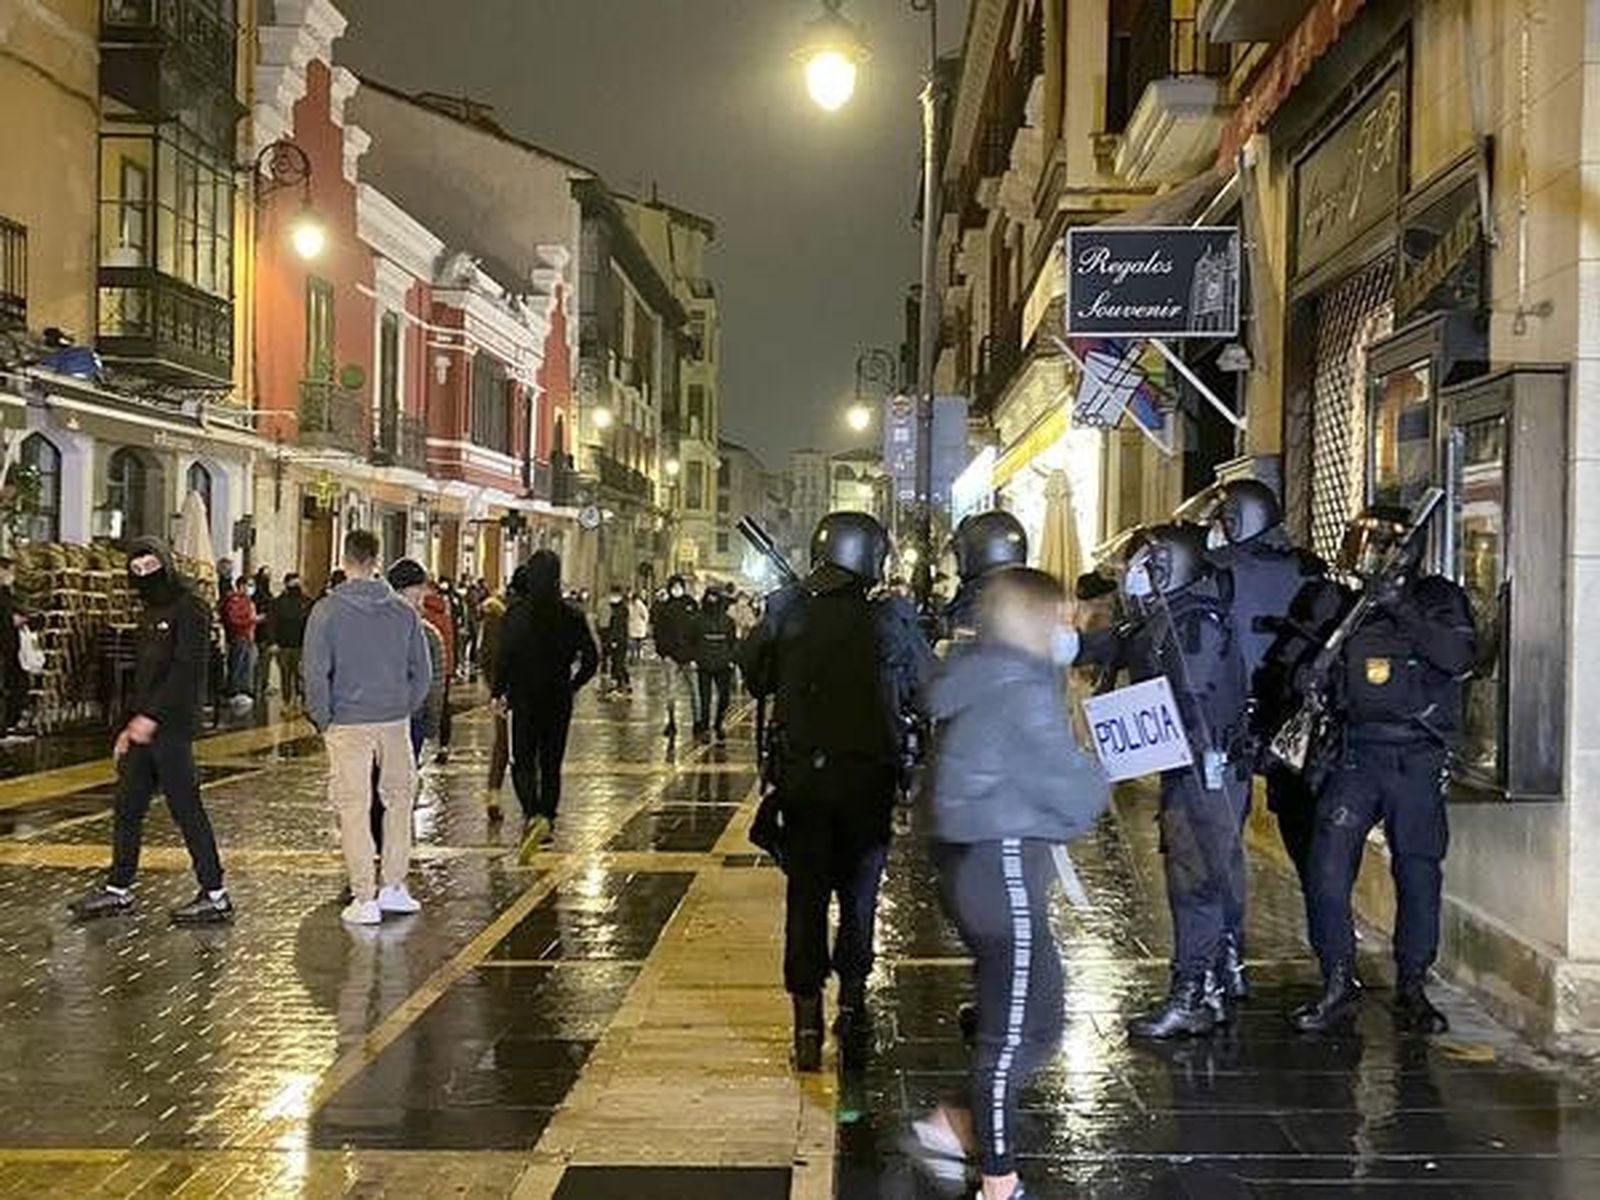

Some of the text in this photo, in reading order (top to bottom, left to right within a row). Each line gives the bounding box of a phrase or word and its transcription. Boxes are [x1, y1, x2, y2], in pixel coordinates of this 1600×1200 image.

[1077, 246, 1174, 284] Regalos
[1077, 290, 1182, 318] Souvenir
[1095, 704, 1180, 758] POLICIA
